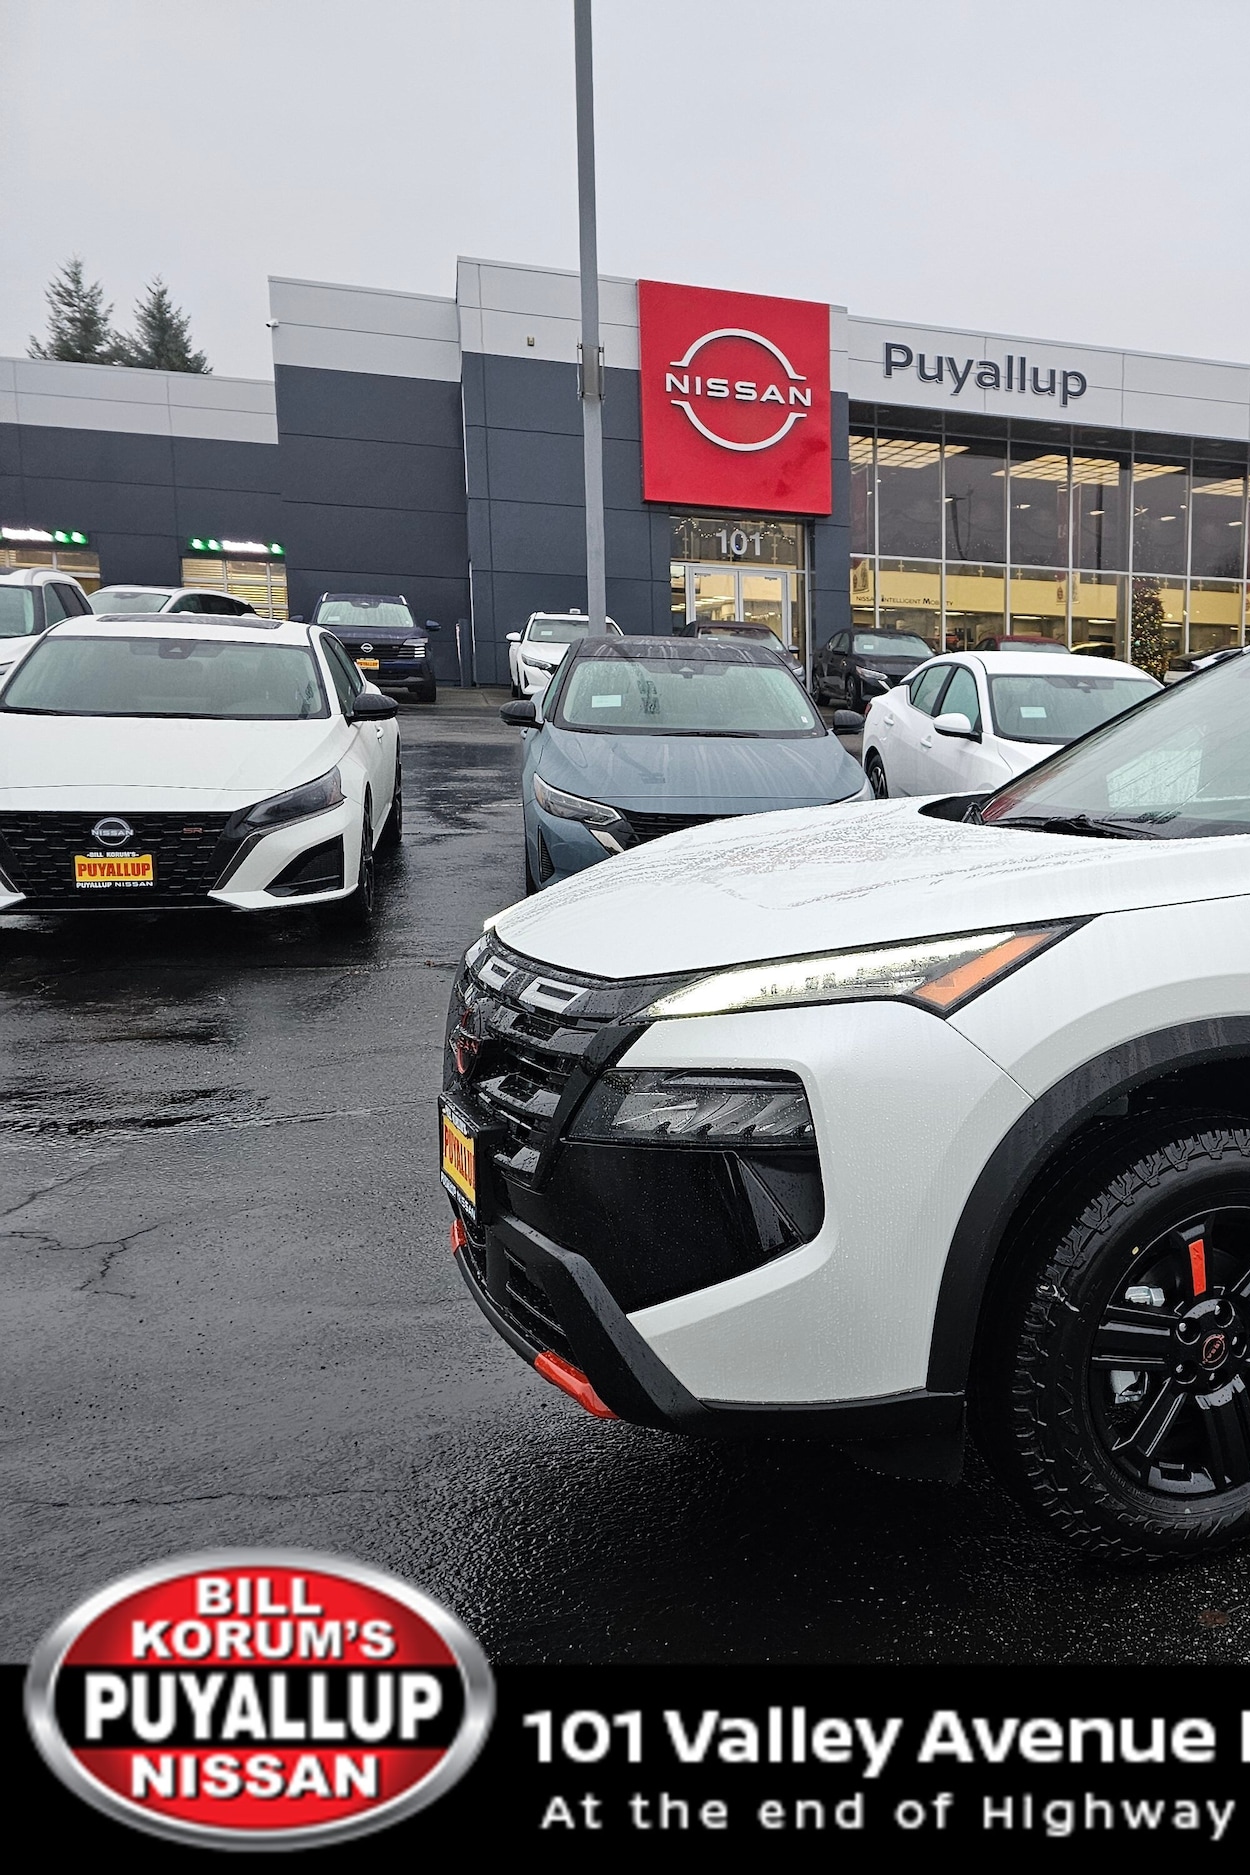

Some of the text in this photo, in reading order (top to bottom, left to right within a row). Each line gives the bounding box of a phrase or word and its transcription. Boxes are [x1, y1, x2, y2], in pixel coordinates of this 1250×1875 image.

[883, 341, 1088, 408] Puyallup
[665, 373, 812, 407] NISSAN
[715, 529, 761, 556] 101
[91, 828, 134, 837] NISSAN
[77, 863, 151, 877] PUYALLUP
[76, 881, 112, 889] PUYALLUP
